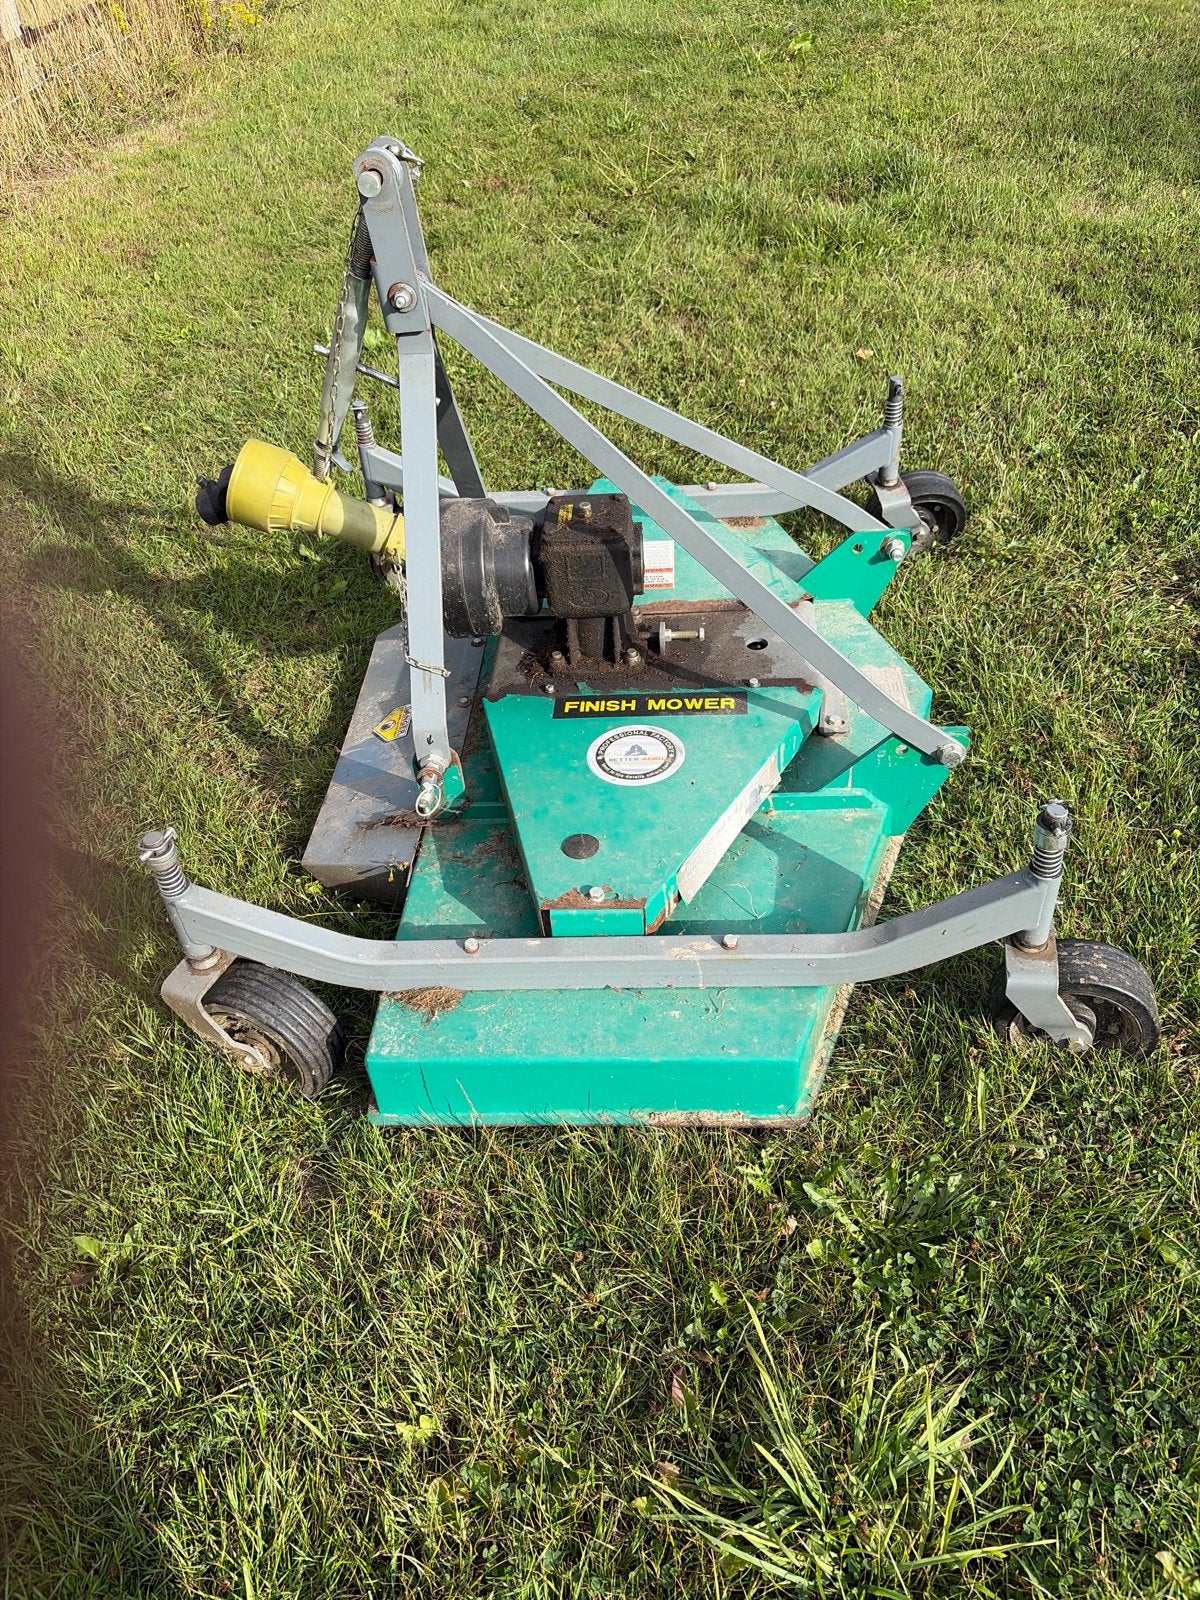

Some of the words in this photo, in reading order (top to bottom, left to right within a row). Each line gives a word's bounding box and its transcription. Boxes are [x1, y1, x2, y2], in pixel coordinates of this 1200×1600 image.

[564, 699, 636, 713] FINISH
[647, 697, 735, 711] MOWER
[598, 730, 649, 754] PROFESSIONAL
[650, 731, 675, 753] FACTORY
